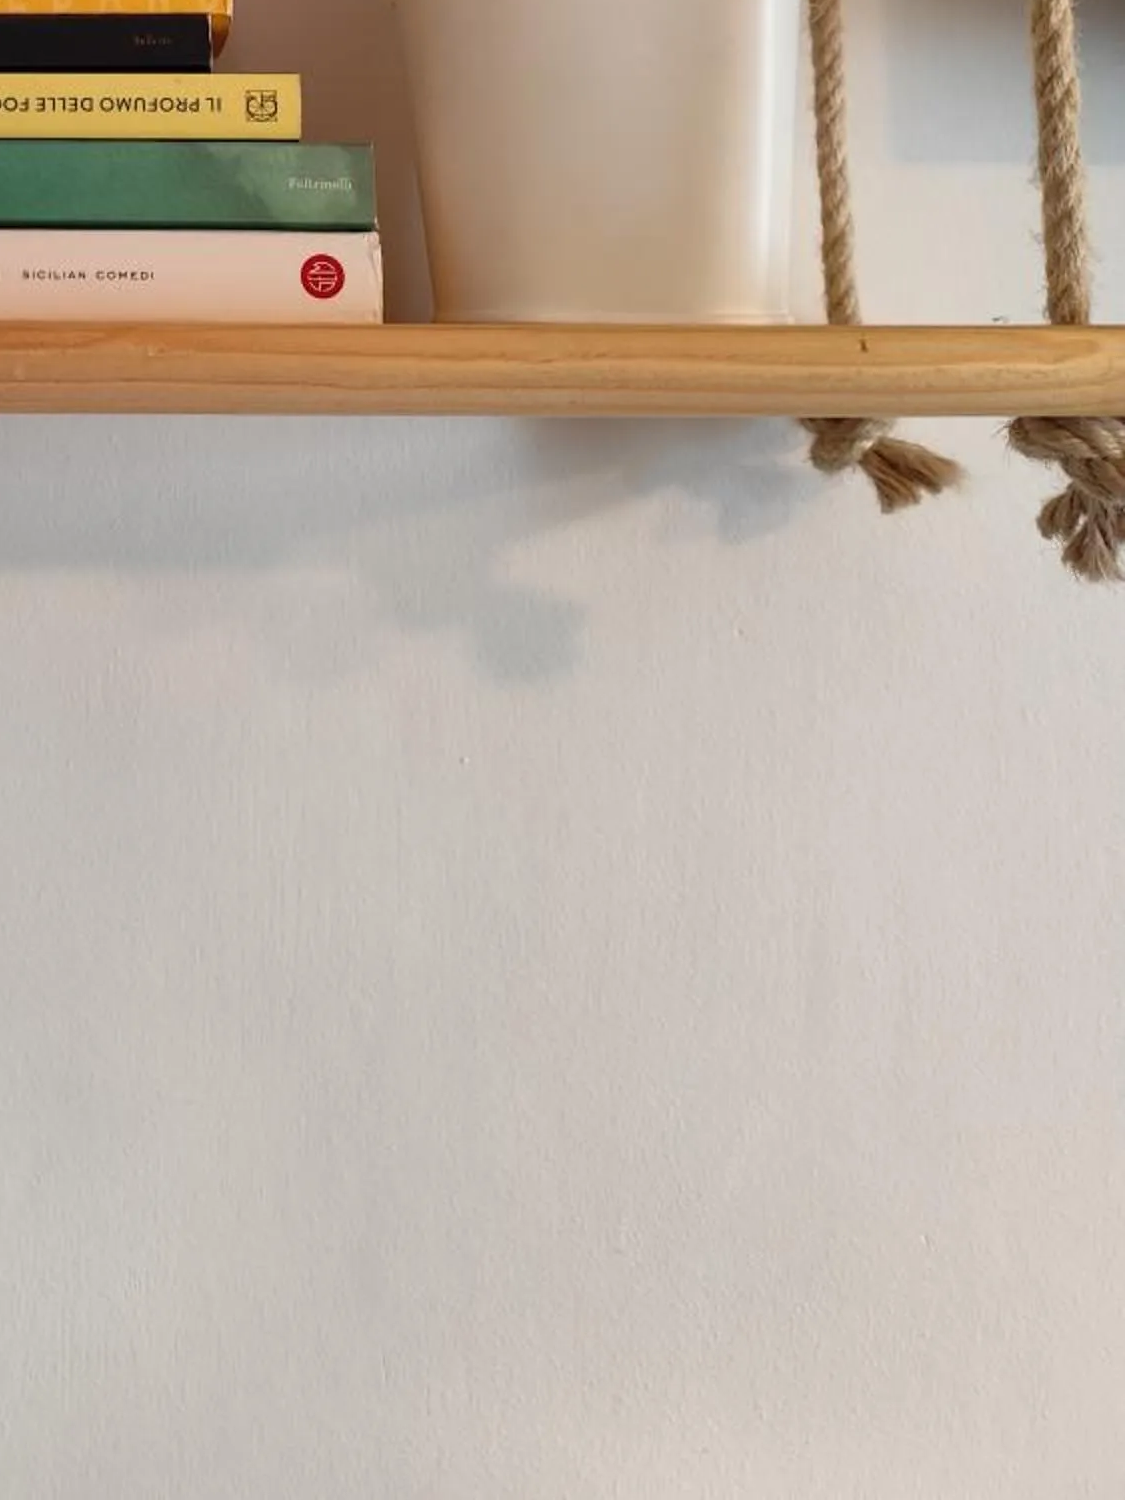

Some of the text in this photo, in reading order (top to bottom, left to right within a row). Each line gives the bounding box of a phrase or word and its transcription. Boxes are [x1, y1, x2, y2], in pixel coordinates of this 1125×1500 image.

[34, 96, 95, 113] DELLE
[99, 96, 201, 113] PROFUMO
[205, 96, 222, 113] IL
[22, 269, 155, 281] SICILIAN COMEDI
